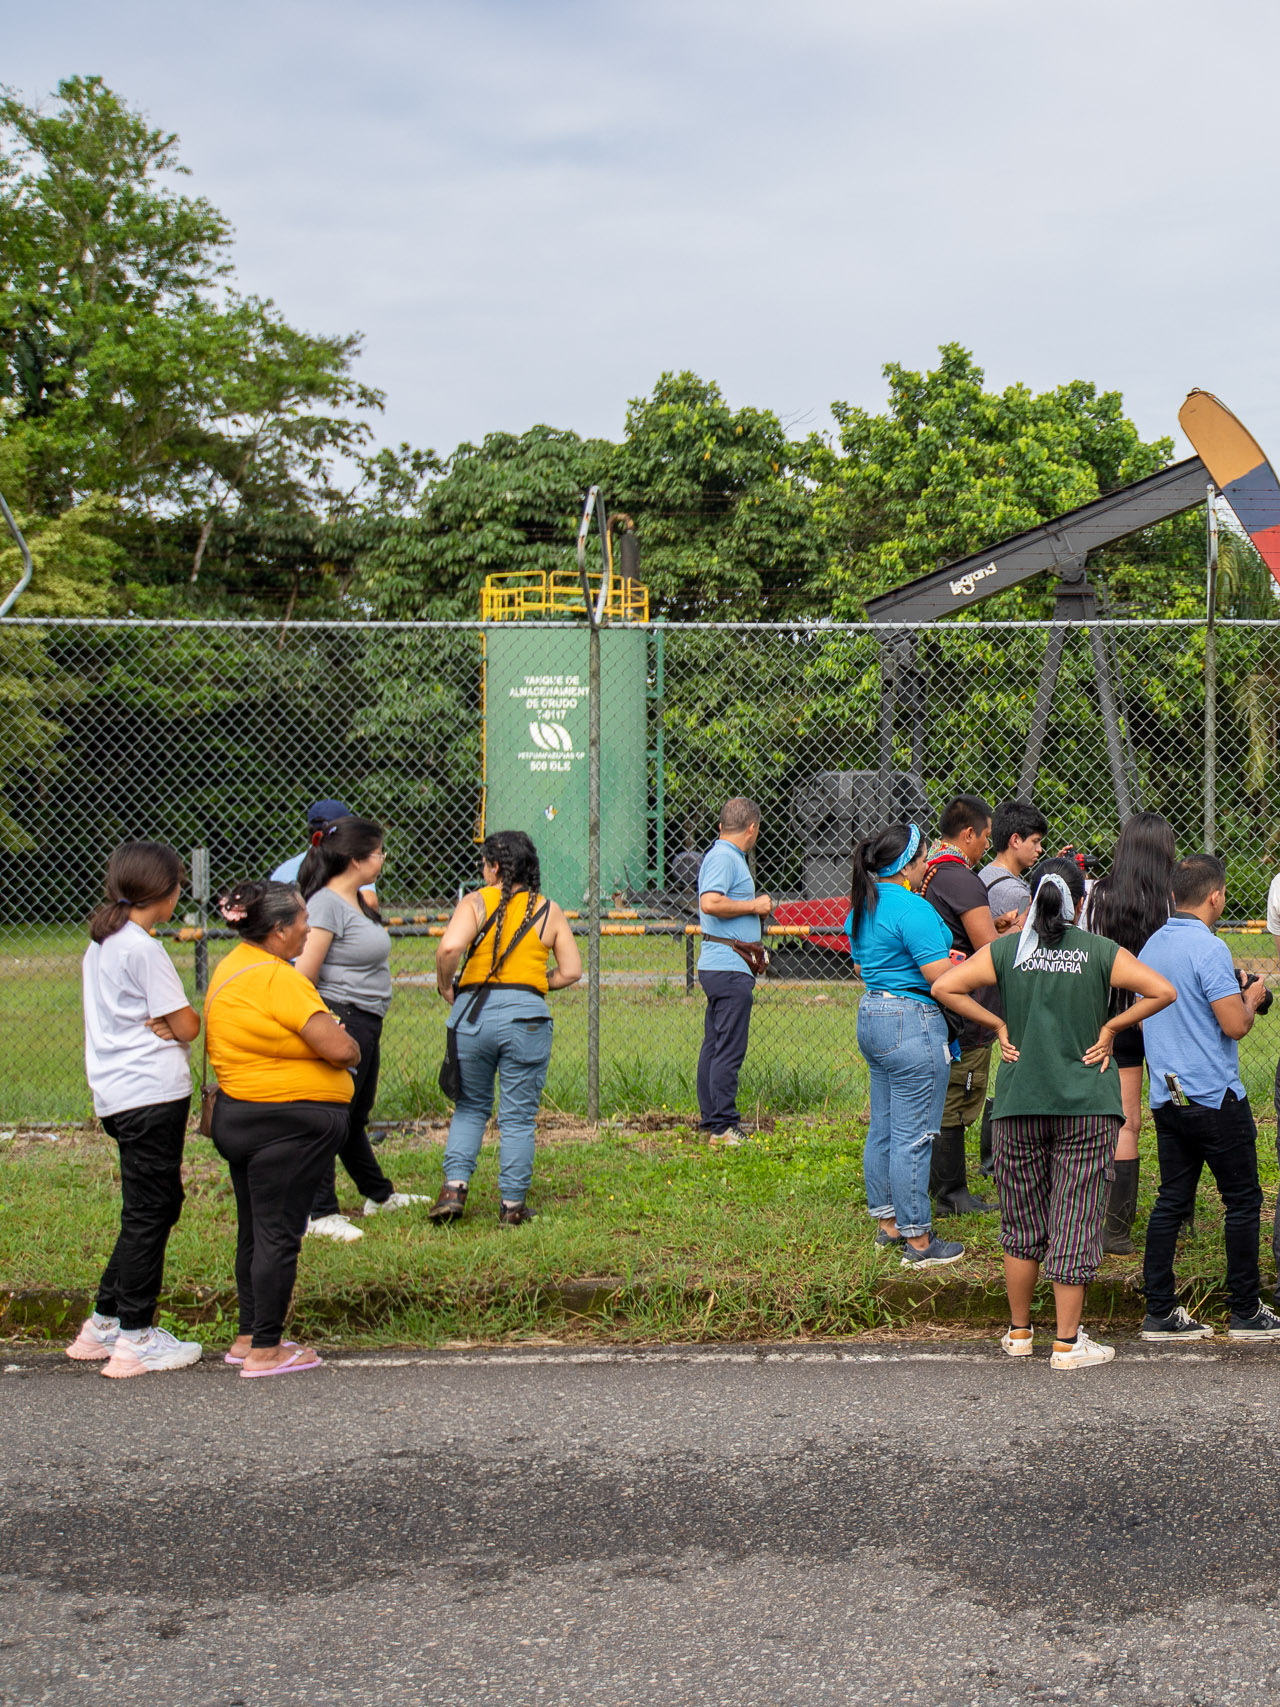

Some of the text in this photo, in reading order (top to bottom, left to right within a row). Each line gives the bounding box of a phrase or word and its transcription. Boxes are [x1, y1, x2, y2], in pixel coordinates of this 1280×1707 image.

[949, 561, 998, 596] legrand
[565, 675, 580, 686] DE
[509, 686, 590, 698] ALMACENAMIENT
[526, 698, 578, 709] DE CRUDO
[1030, 947, 1089, 963] MUNICACIÓN
